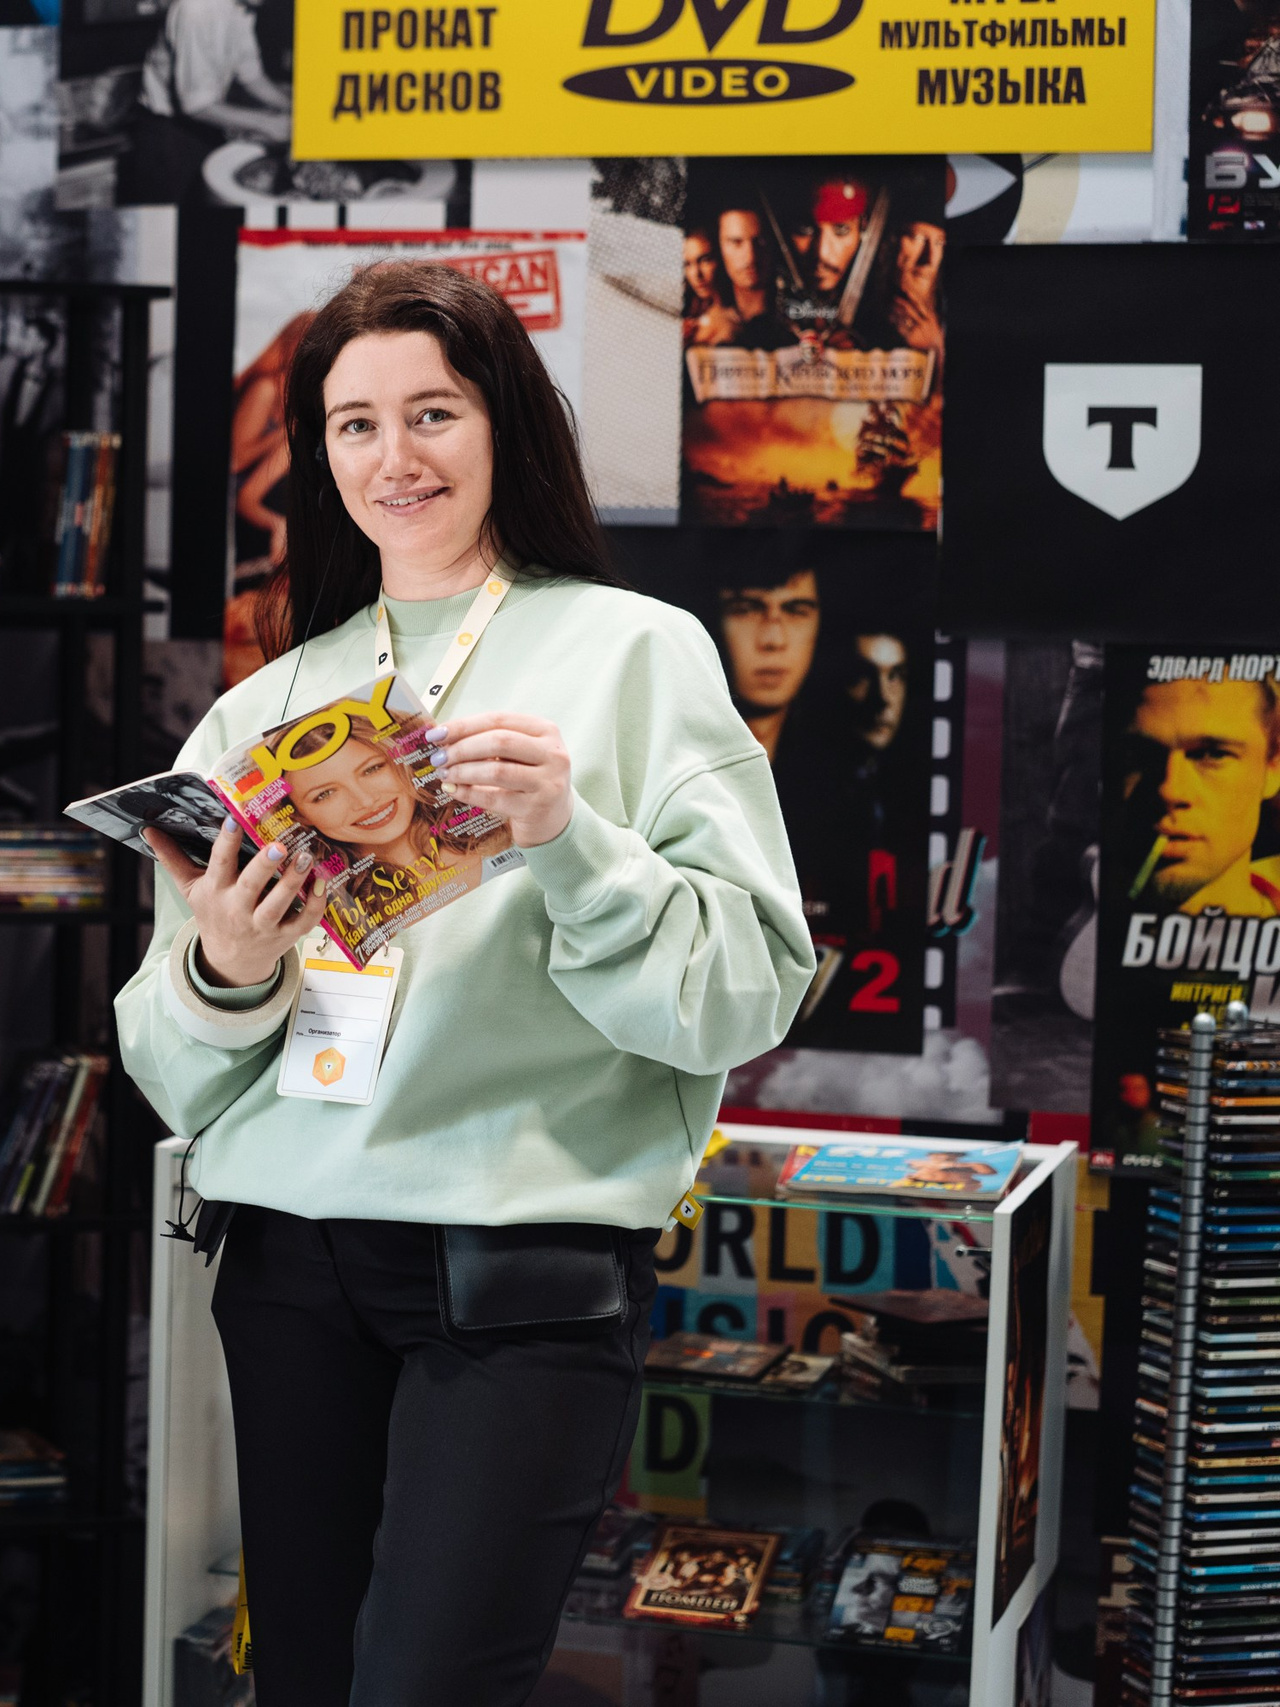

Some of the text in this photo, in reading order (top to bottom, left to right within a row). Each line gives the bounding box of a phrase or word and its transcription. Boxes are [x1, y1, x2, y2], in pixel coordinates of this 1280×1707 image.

[342, 8, 497, 51] ПРОКАТ
[580, 0, 865, 57] DVD
[879, 17, 1128, 50] МУЛЬТФИЛЬМЫ
[332, 71, 503, 121] ДИСКОВ
[625, 66, 790, 98] VIDEO
[916, 67, 1087, 106] МУЗЫКА
[1087, 406, 1158, 470] T
[1147, 656, 1225, 682] ЭДВАРД
[232, 675, 396, 801] JOY
[243, 778, 286, 818] СУПЕРЦЕНА
[252, 789, 287, 819] 37 РУБЛЕЙ
[372, 837, 447, 900] Sexy!
[344, 923, 368, 950] Как
[368, 910, 383, 930] ни
[383, 891, 415, 916] одна
[354, 881, 458, 964] 7 проверенных способов стать
[365, 881, 468, 956] обезоруживающе сексуальной
[1121, 906, 1280, 981] БОЙЦО
[848, 949, 901, 1014] 2
[308, 1028, 342, 1038] Организатор
